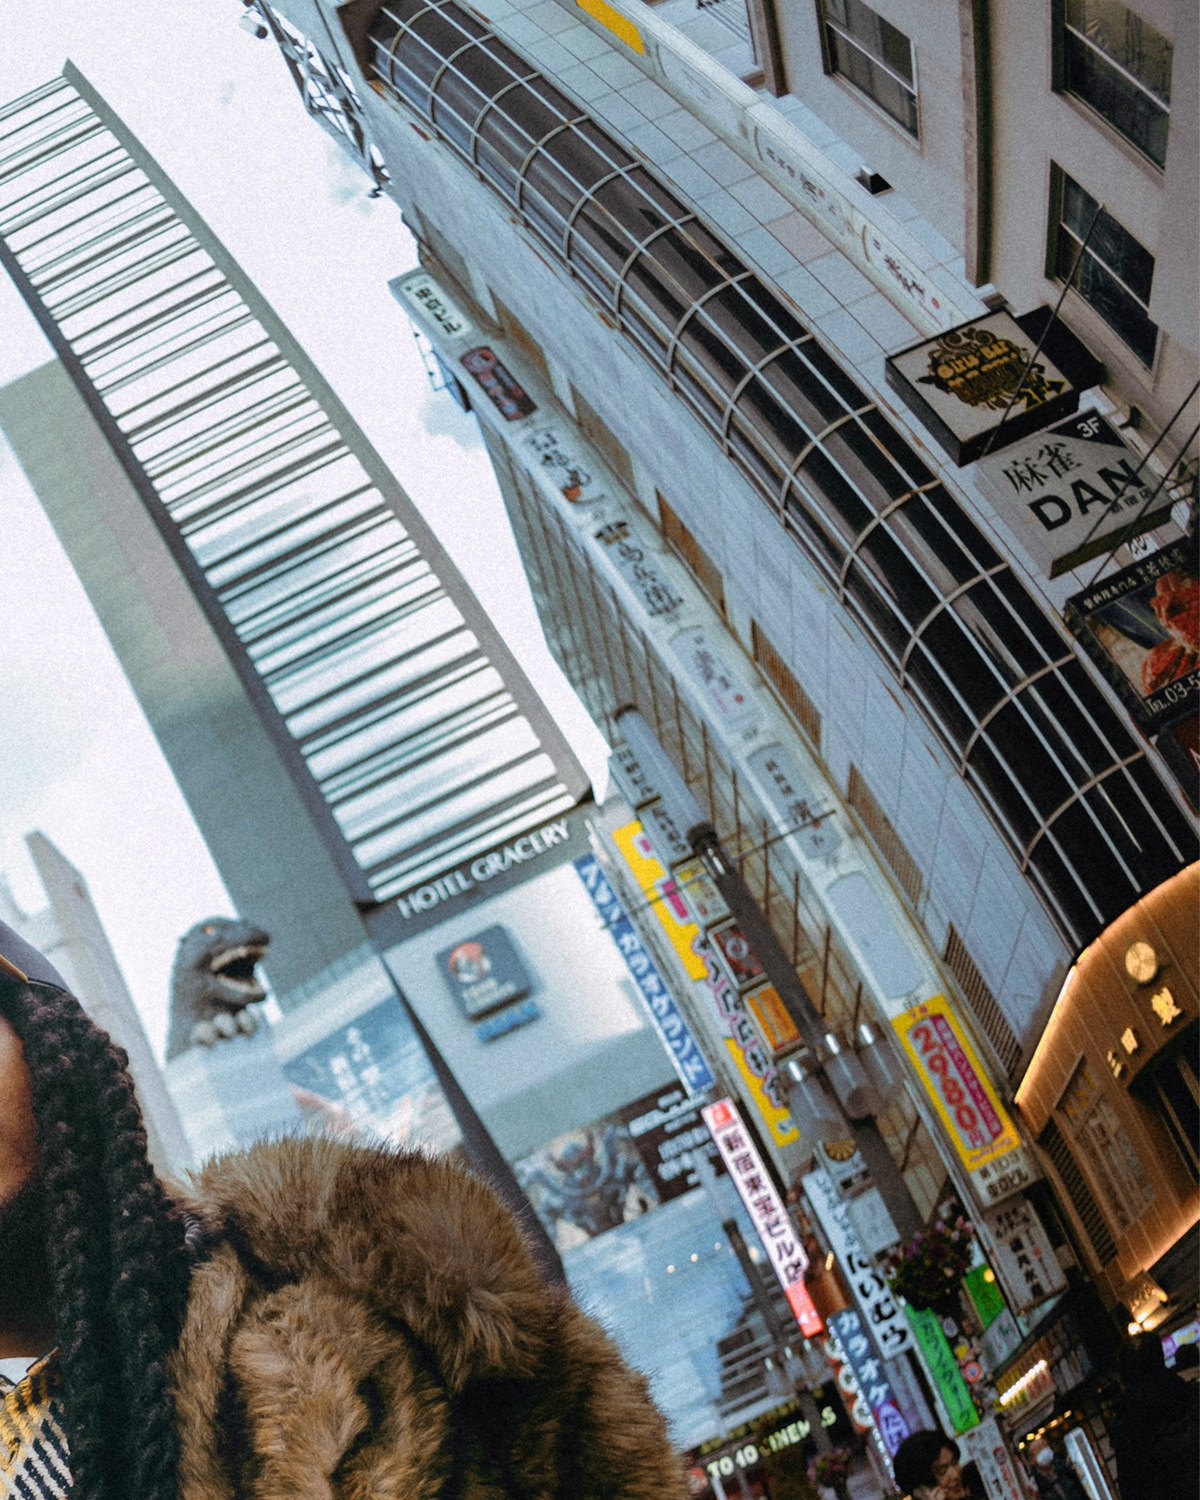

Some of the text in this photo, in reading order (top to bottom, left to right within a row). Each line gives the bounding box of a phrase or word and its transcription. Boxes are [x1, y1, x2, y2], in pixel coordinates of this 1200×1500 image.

[1077, 417, 1100, 438] 3F
[1003, 443, 1081, 494] 麻雀
[1028, 459, 1146, 531] DAN
[1149, 683, 1200, 714] TEL.03-5
[397, 820, 570, 920] HOTEL GRACERY
[845, 1250, 907, 1345] にいむら
[838, 1313, 889, 1403] カラオケ
